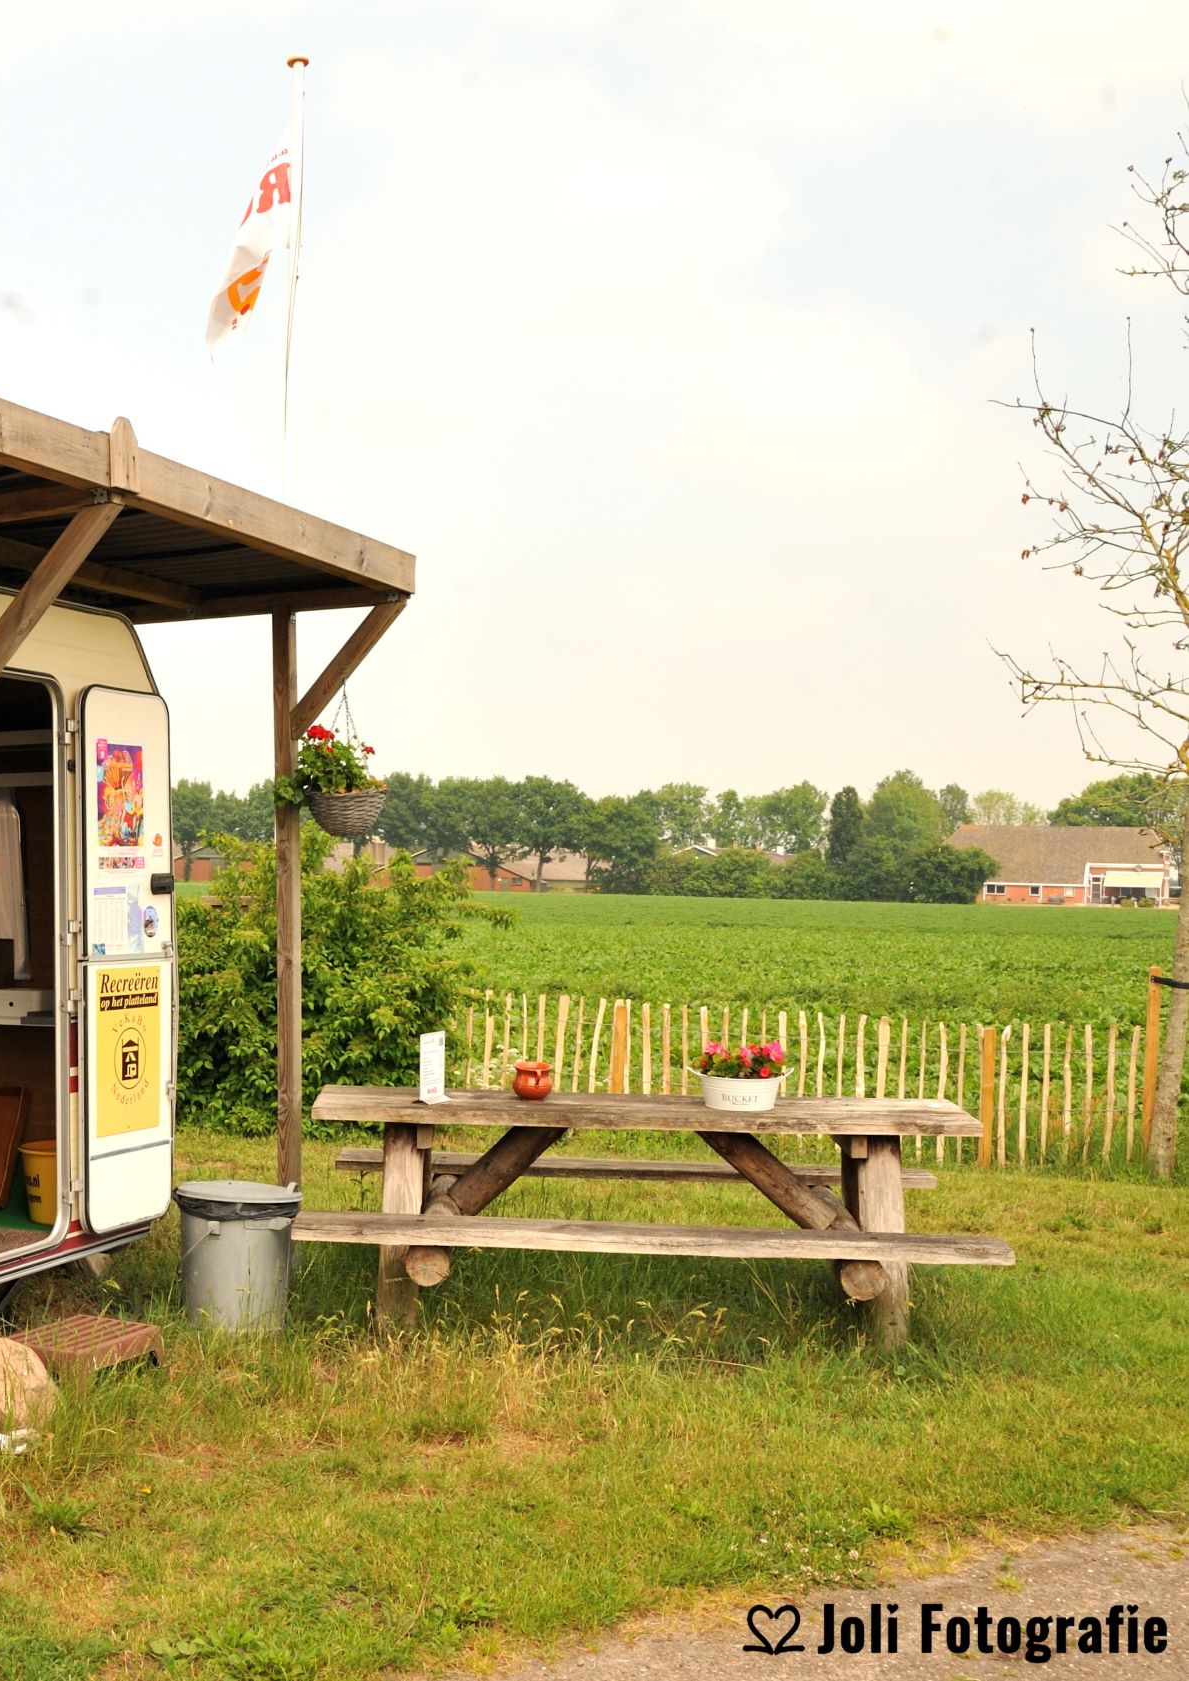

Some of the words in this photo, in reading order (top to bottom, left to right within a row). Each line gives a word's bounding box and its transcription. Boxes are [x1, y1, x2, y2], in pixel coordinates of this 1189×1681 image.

[100, 972, 158, 994] Recreëren
[100, 1000, 110, 1011] op
[112, 996, 124, 1010] het
[124, 993, 157, 1009] platteland
[110, 1078, 149, 1105] Nederland
[722, 1093, 758, 1103] BUCKET
